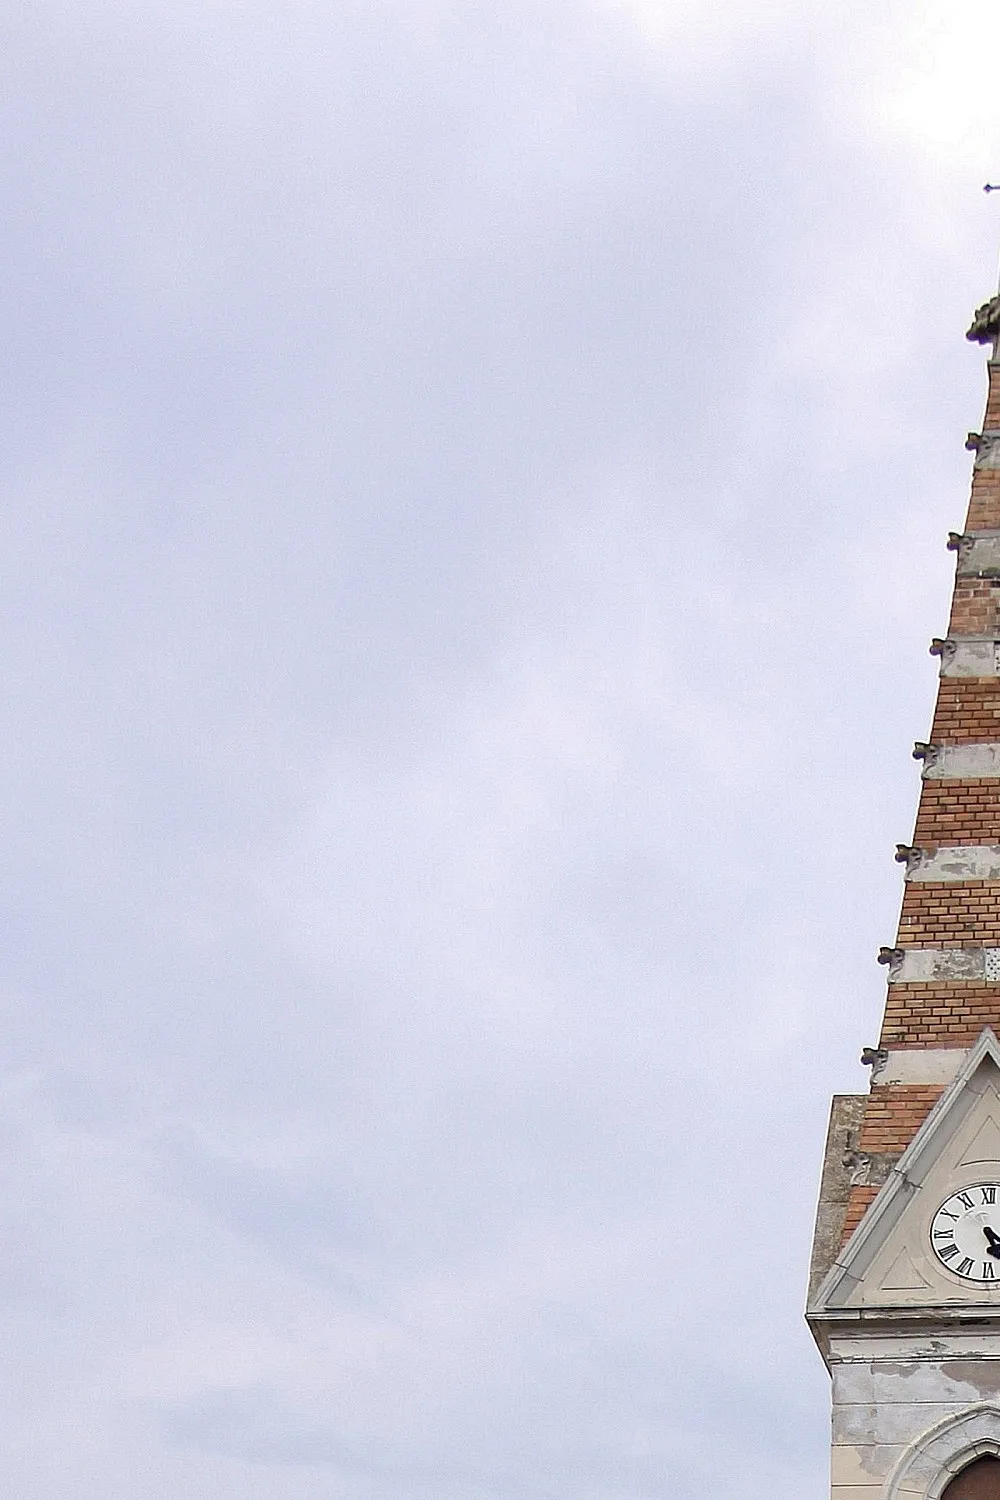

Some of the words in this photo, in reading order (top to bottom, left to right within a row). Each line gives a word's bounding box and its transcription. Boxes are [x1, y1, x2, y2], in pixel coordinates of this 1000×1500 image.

[956, 1192, 975, 1210] XI
[980, 1187, 997, 1205] XII
[940, 1208, 960, 1222] X
[934, 1229, 953, 1239] IX
[938, 1243, 960, 1262] VIII
[955, 1257, 975, 1276] VII
[983, 1262, 995, 1278] VI
